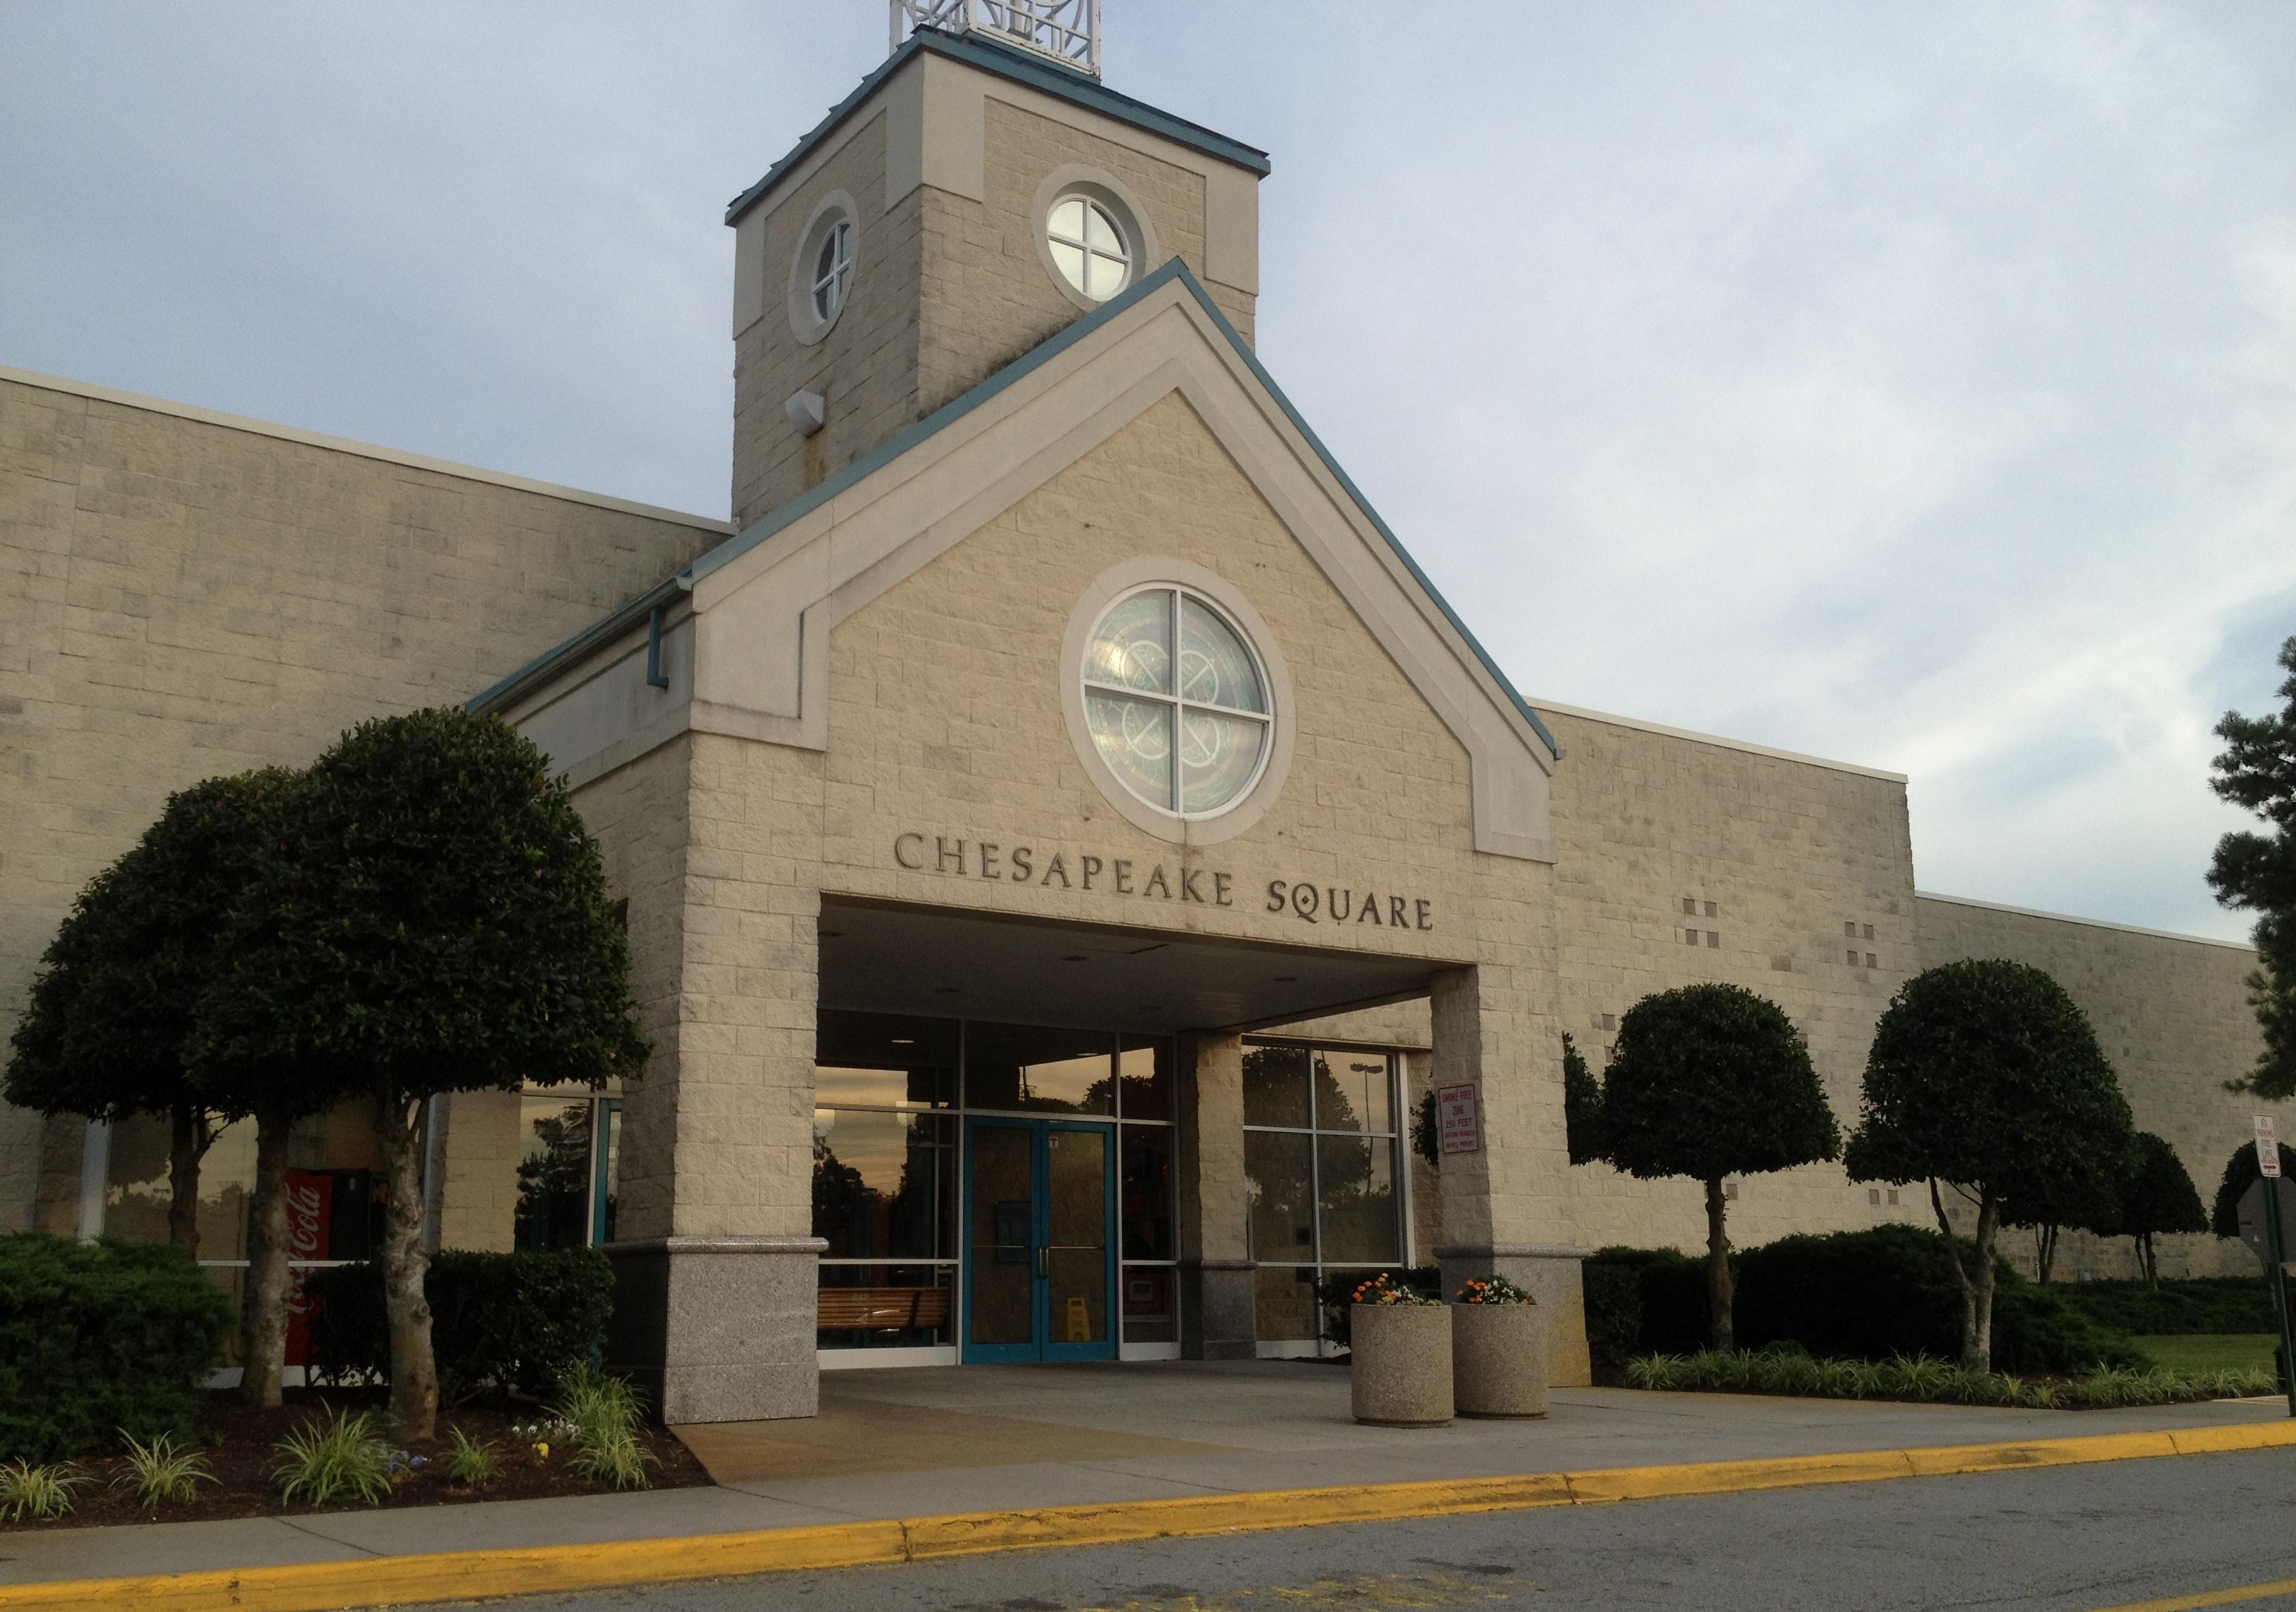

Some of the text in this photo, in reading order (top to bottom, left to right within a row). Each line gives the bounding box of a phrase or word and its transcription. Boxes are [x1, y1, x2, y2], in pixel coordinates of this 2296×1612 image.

[894, 832, 1433, 931] CHESAPEAKE SQUARE
[1460, 1091, 1472, 1100] FREE
[1458, 1118, 1472, 1127] FEET
